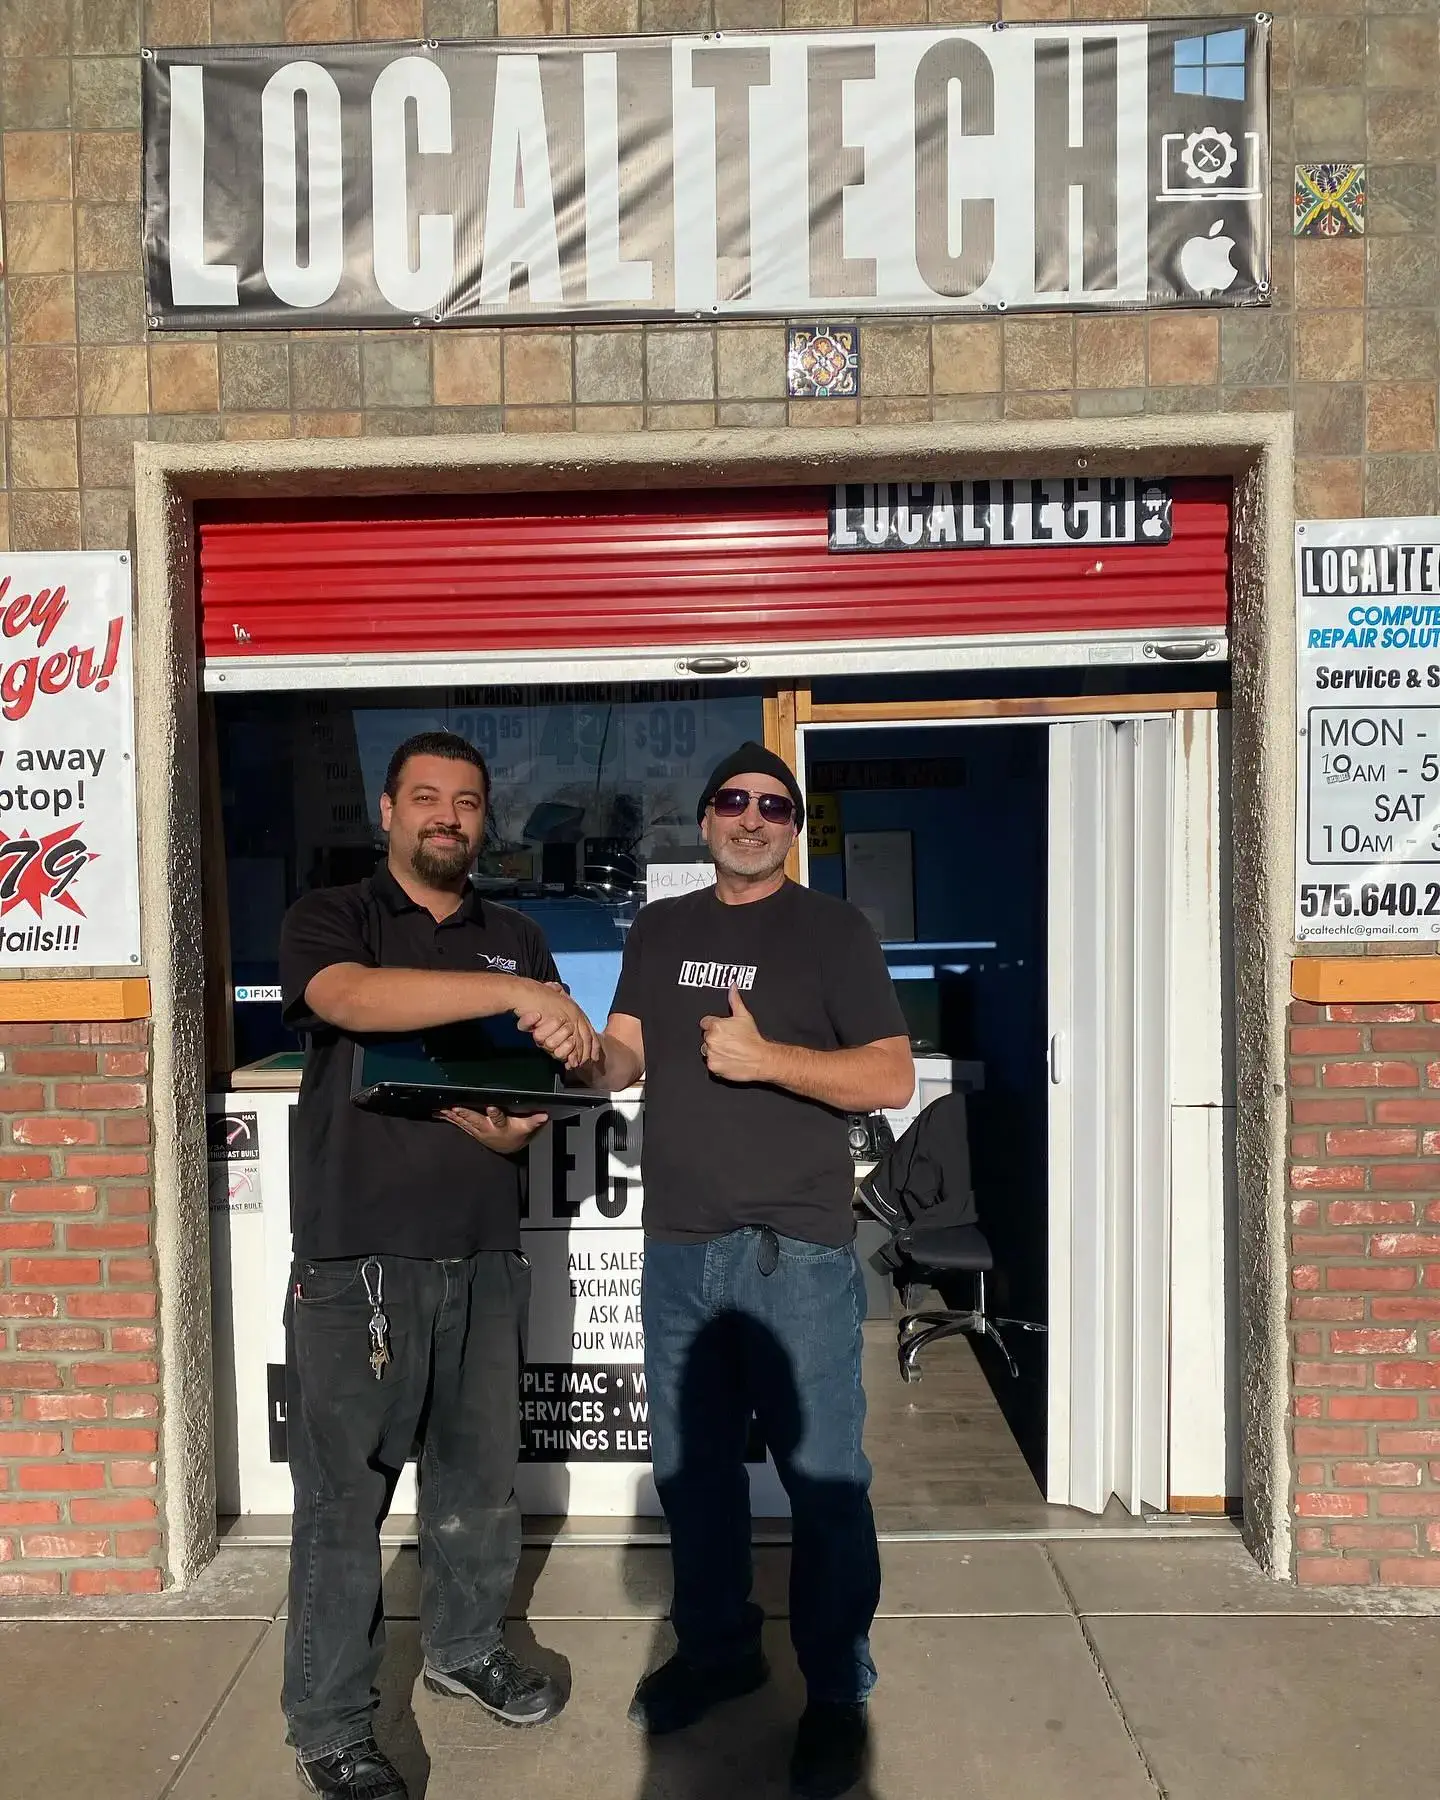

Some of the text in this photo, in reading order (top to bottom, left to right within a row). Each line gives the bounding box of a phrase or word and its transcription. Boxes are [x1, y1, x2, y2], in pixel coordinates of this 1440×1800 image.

[168, 37, 1118, 312] LOCALTECH
[1305, 547, 1440, 594] LOCALTE
[1307, 628, 1378, 648] REPAIR
[0, 615, 123, 721] ger!
[1316, 666, 1401, 689] Service
[1406, 669, 1421, 688] &
[1320, 718, 1404, 746] MON
[16, 748, 106, 777] away
[1374, 794, 1426, 823] SAT
[1322, 824, 1393, 852] 10AM
[1300, 924, 1419, 937] localtechlc@gmail.com
[241, 1149, 259, 1158] BUILT
[244, 1202, 262, 1210] BUILT
[567, 1252, 596, 1271] ALL
[589, 1305, 619, 1324] ASK
[571, 1331, 605, 1350] OUR
[520, 1372, 556, 1393] PLE
[561, 1372, 608, 1394] MAC
[531, 1429, 609, 1450] THINGS
[616, 1430, 652, 1450] ELE
